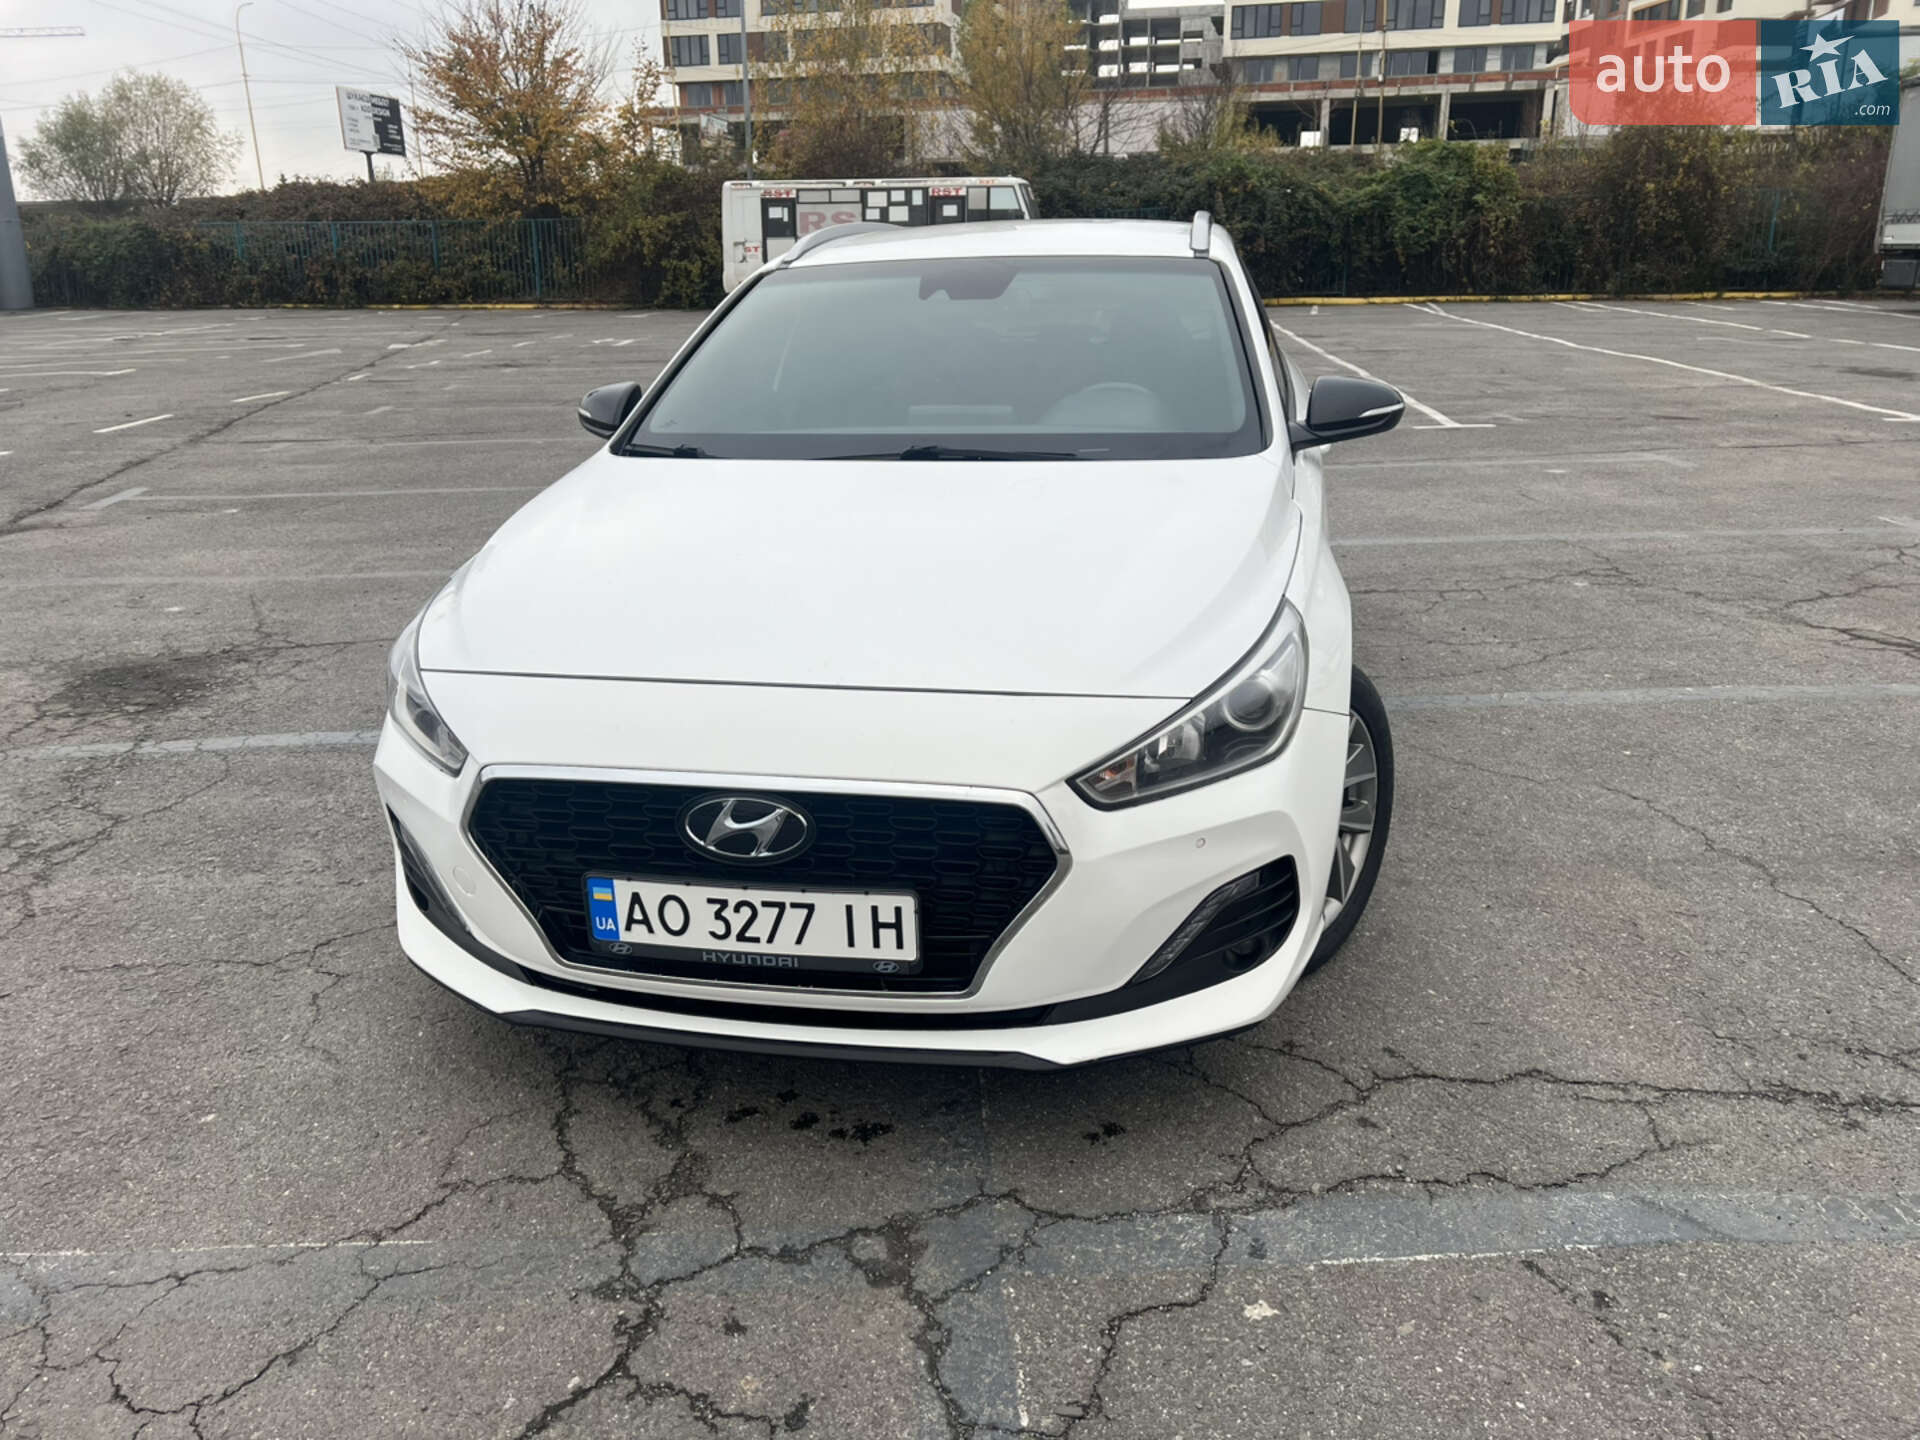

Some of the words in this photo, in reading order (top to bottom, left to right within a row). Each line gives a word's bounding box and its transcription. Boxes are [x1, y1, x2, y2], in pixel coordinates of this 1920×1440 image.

[931, 187, 963, 197] RST
[595, 916, 616, 932] UA
[624, 891, 690, 937] AO
[706, 897, 815, 947] 3277
[845, 903, 904, 950] IH
[702, 951, 799, 969] HYUNDAI
